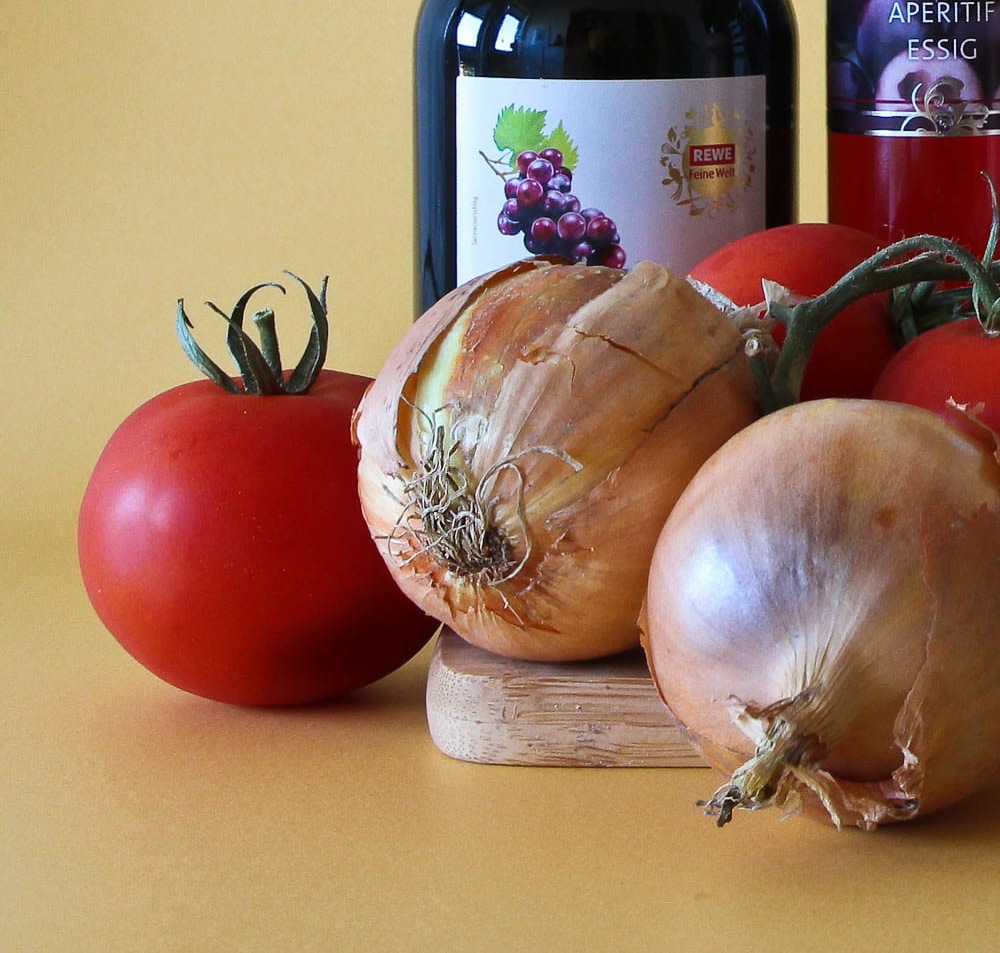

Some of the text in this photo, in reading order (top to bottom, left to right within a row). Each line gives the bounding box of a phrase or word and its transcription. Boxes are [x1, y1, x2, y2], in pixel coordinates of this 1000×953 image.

[888, 0, 996, 24] APERITIF
[908, 38, 977, 61] ESSIG
[693, 147, 732, 162] REWE
[689, 167, 735, 180] Feine Welt
